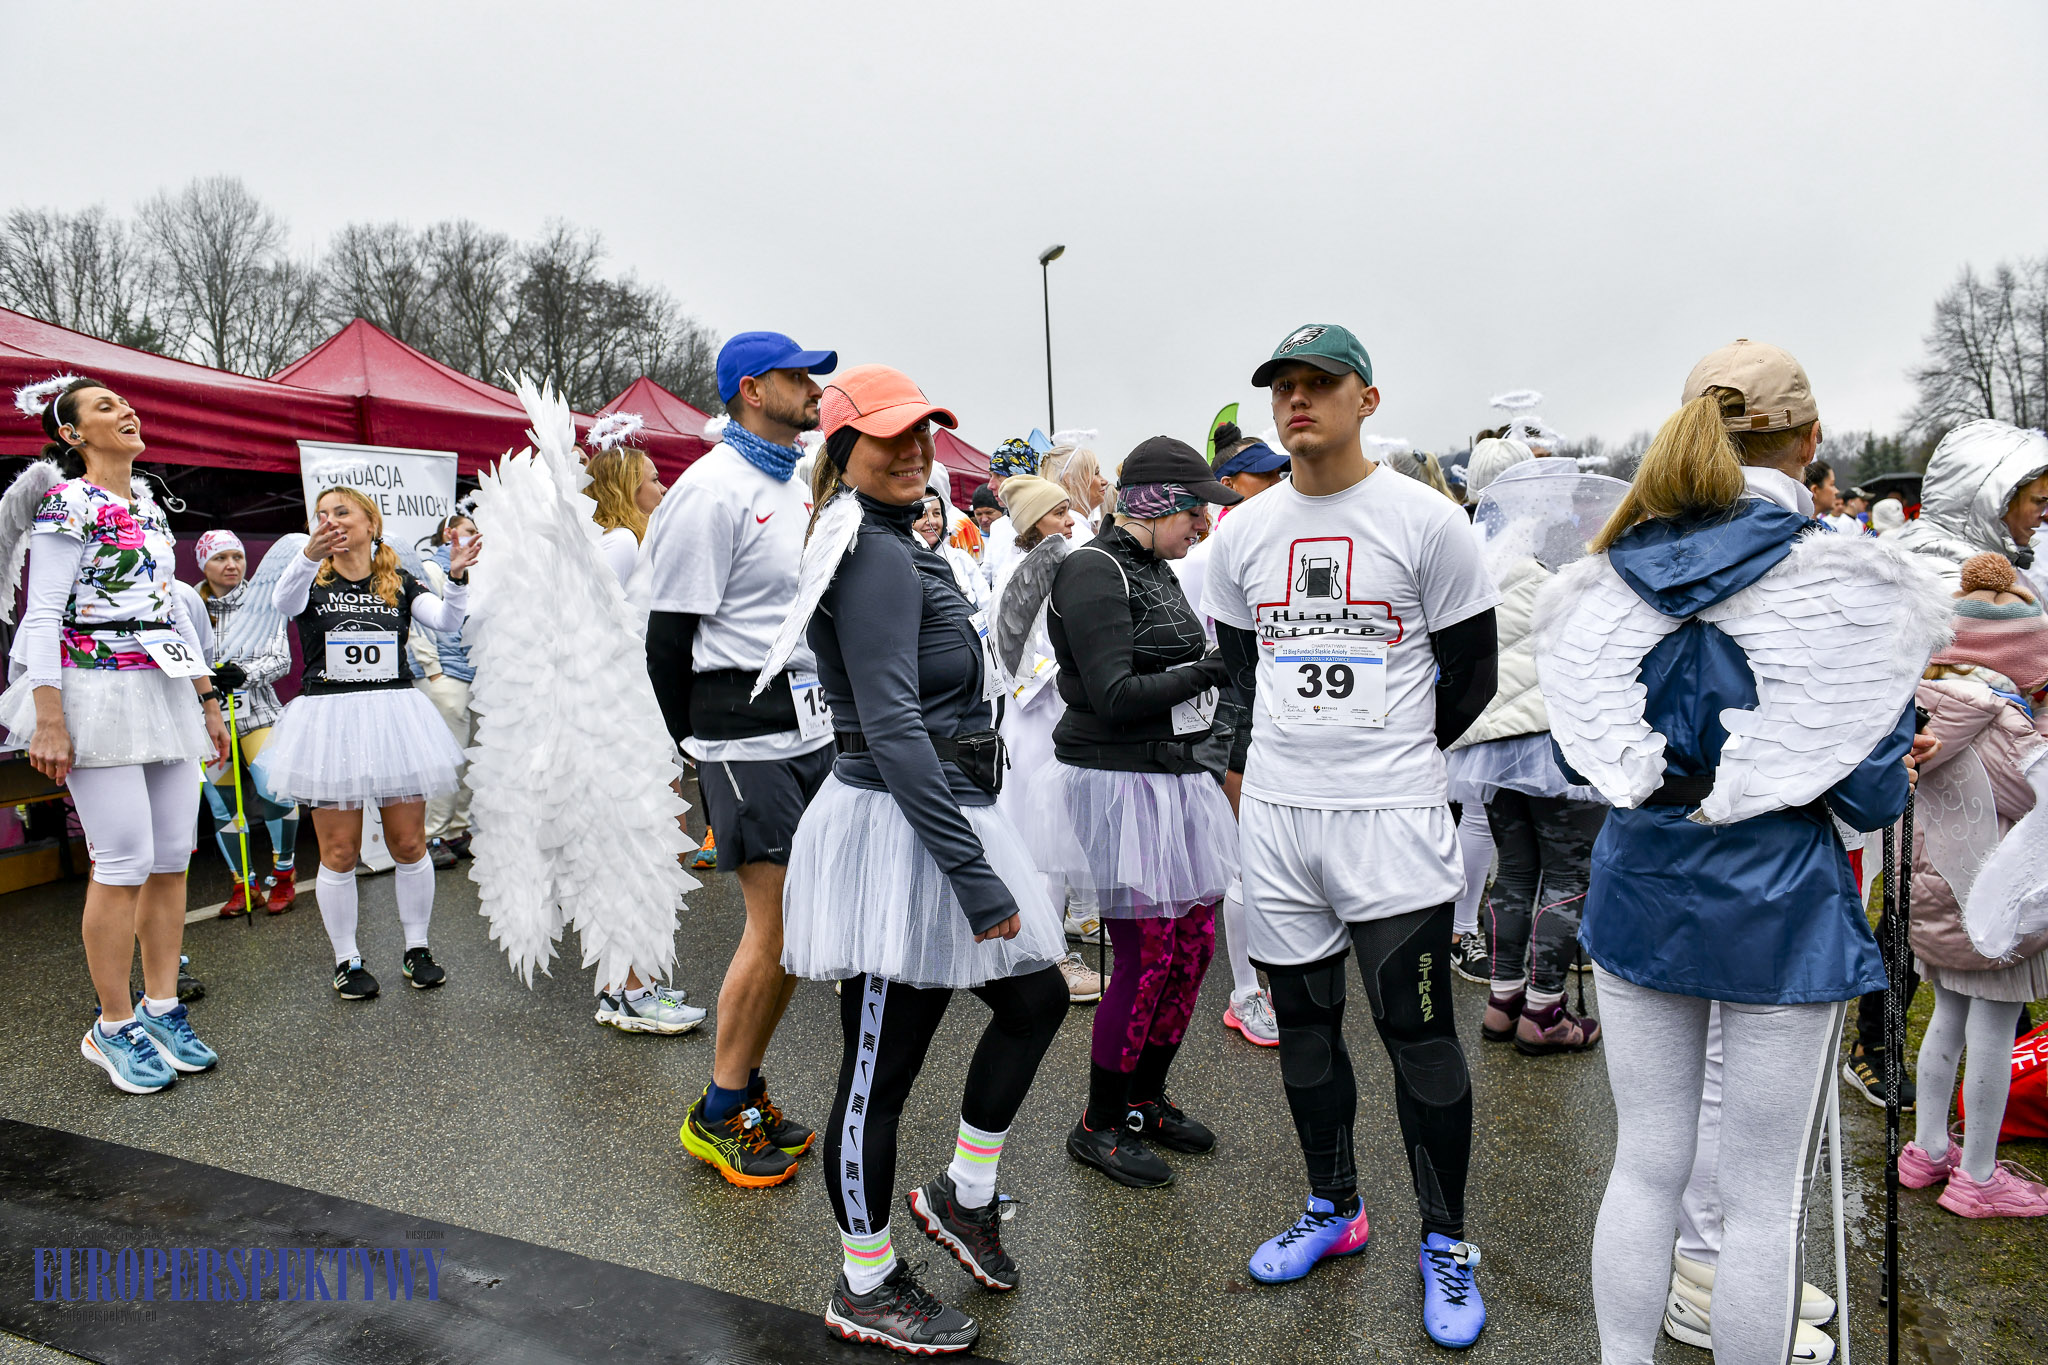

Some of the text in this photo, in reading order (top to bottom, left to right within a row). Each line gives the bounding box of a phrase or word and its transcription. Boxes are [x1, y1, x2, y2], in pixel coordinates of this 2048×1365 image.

[397, 494, 448, 517] ANIOŁY
[37, 512, 65, 521] HERO
[328, 592, 386, 604] MORS
[315, 603, 399, 617] HUBERTUS
[1270, 608, 1372, 622] High
[1264, 625, 1385, 639] Octane
[163, 643, 194, 662] 92
[344, 645, 381, 665] 90
[1297, 663, 1355, 699] 39
[869, 974, 885, 996] NIKE
[863, 1031, 876, 1053] NIKE
[851, 1092, 865, 1116] NIKE
[845, 1160, 859, 1181] NIKE
[852, 1217, 867, 1234] NIKE
[1673, 1302, 1686, 1314] NIKE
